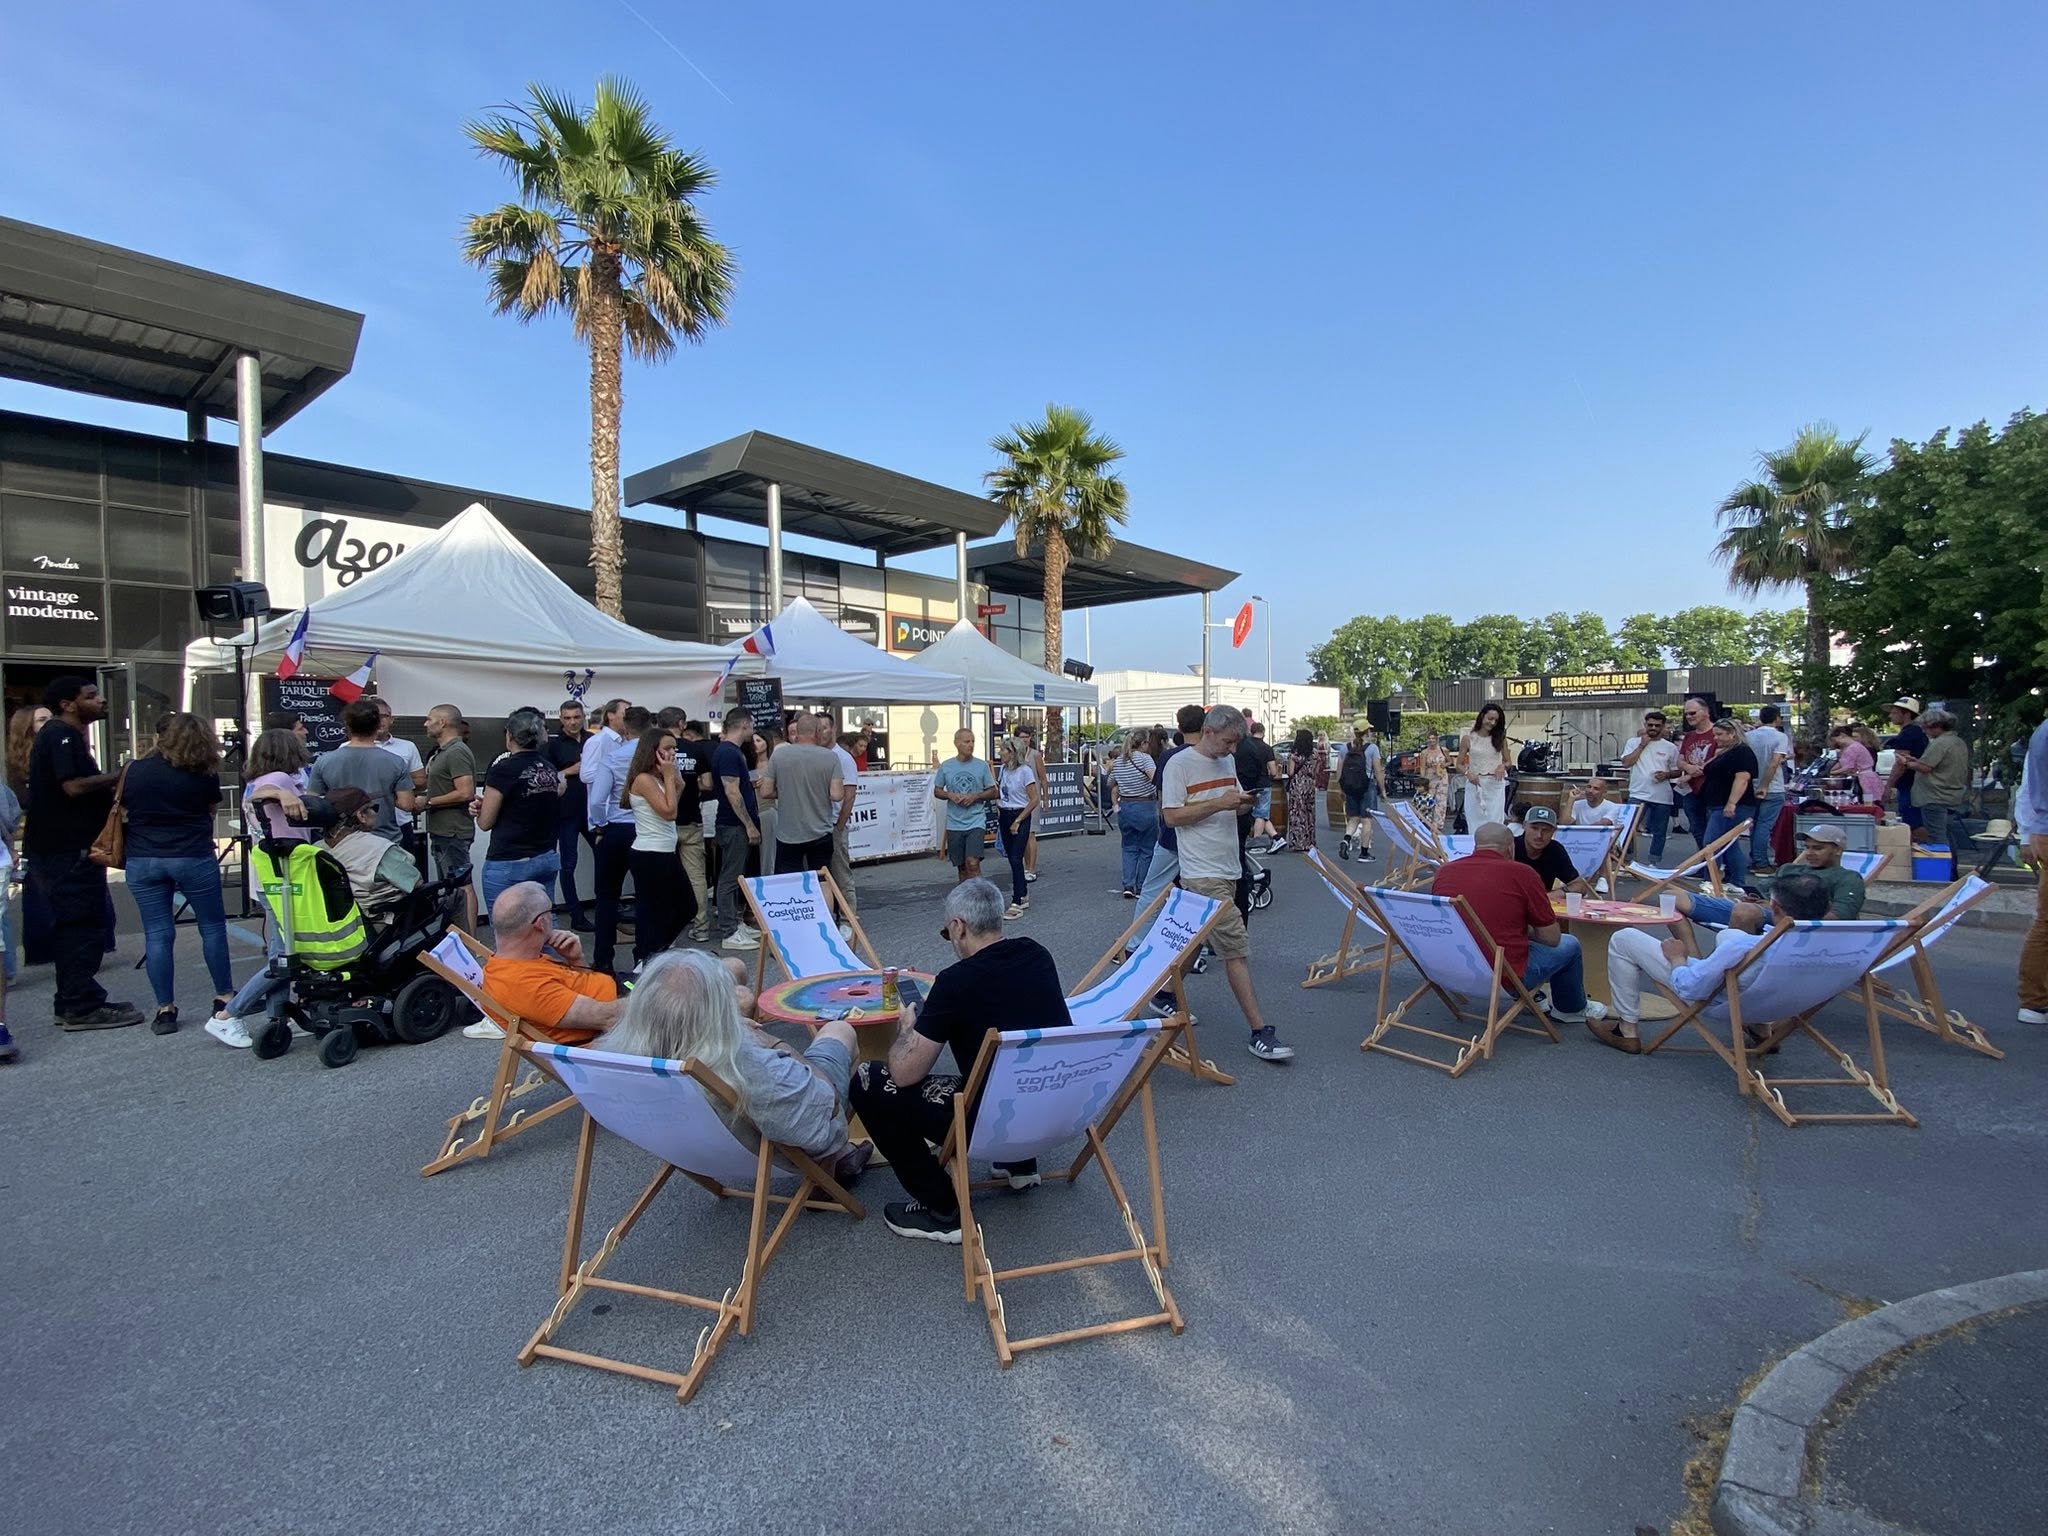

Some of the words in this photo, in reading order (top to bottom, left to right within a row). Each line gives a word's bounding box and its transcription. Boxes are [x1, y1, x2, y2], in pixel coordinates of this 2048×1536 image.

[295, 519, 405, 588] azo
[33, 555, 80, 570] Fender
[7, 586, 80, 606] vintage
[8, 604, 99, 621] moderne.
[912, 627, 946, 642] POINT
[1551, 675, 1611, 687] DESTOCKAGE
[1612, 674, 1624, 685] DE
[1625, 674, 1649, 684] LUXE
[279, 685, 331, 699] TARIQUET
[1260, 689, 1286, 704] ORT
[1510, 683, 1523, 696] Le
[1524, 682, 1537, 695] 18
[1261, 705, 1287, 724] NTÉ
[319, 726, 346, 739] 3,50€
[1057, 772, 1065, 782] LE
[1066, 771, 1075, 781] LEZ
[768, 906, 815, 919] Castelnau
[1161, 927, 1190, 944] Castelna
